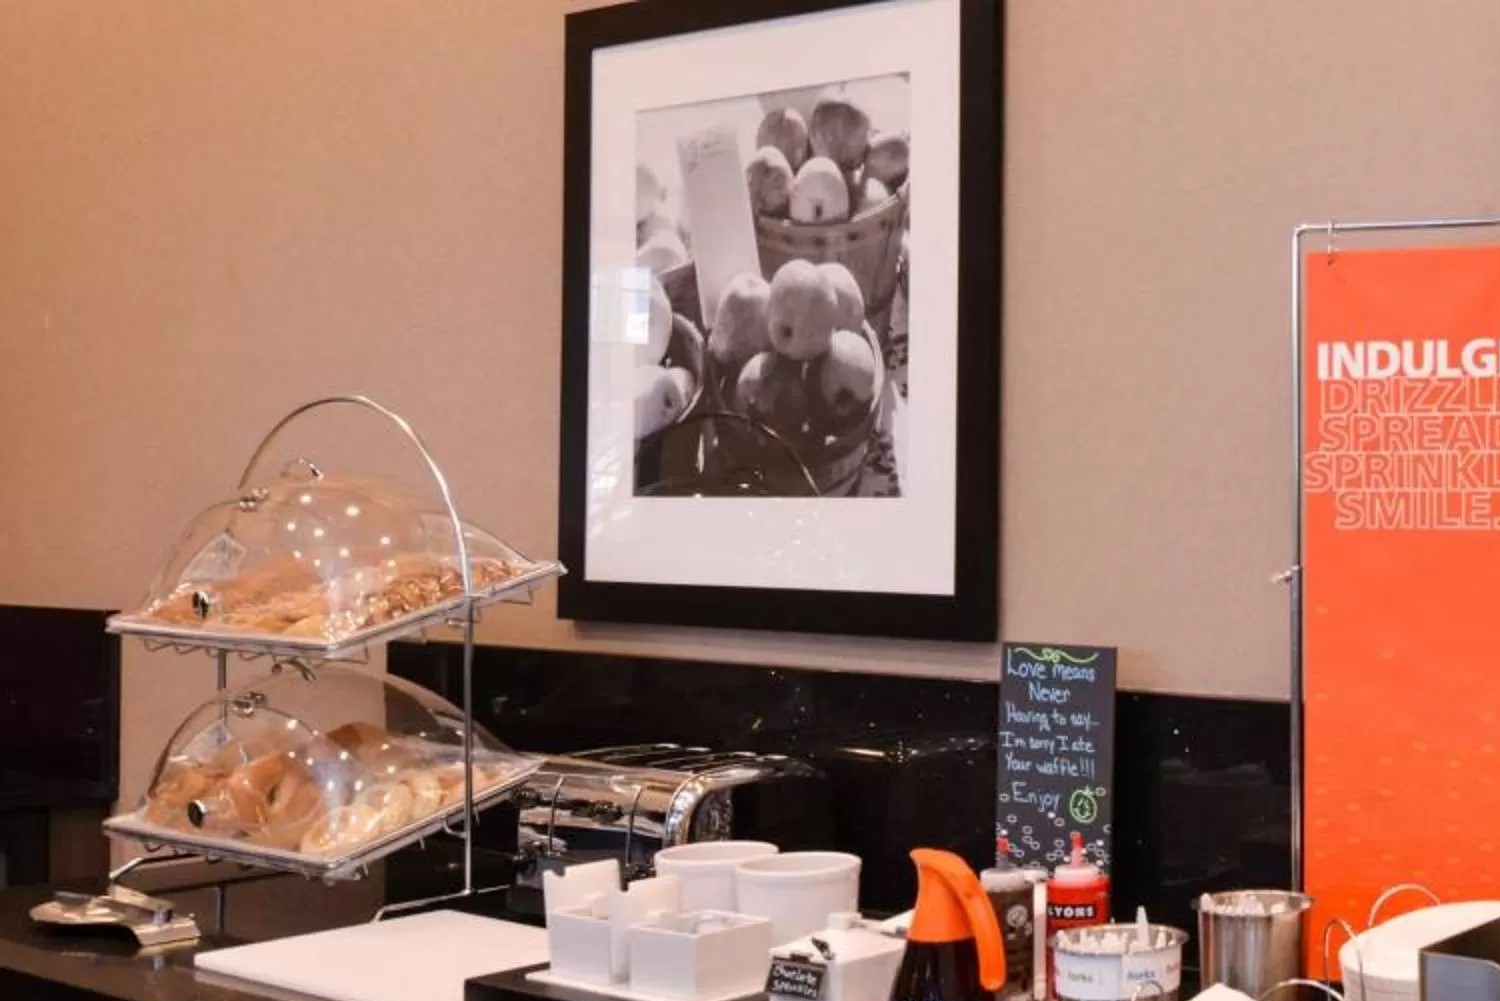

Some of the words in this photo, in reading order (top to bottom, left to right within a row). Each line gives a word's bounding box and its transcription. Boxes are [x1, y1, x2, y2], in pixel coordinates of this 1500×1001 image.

[1007, 648, 1047, 679] Love
[1028, 680, 1071, 703] Never
[1052, 708, 1068, 725] to
[1011, 781, 1061, 813] Enjoy
